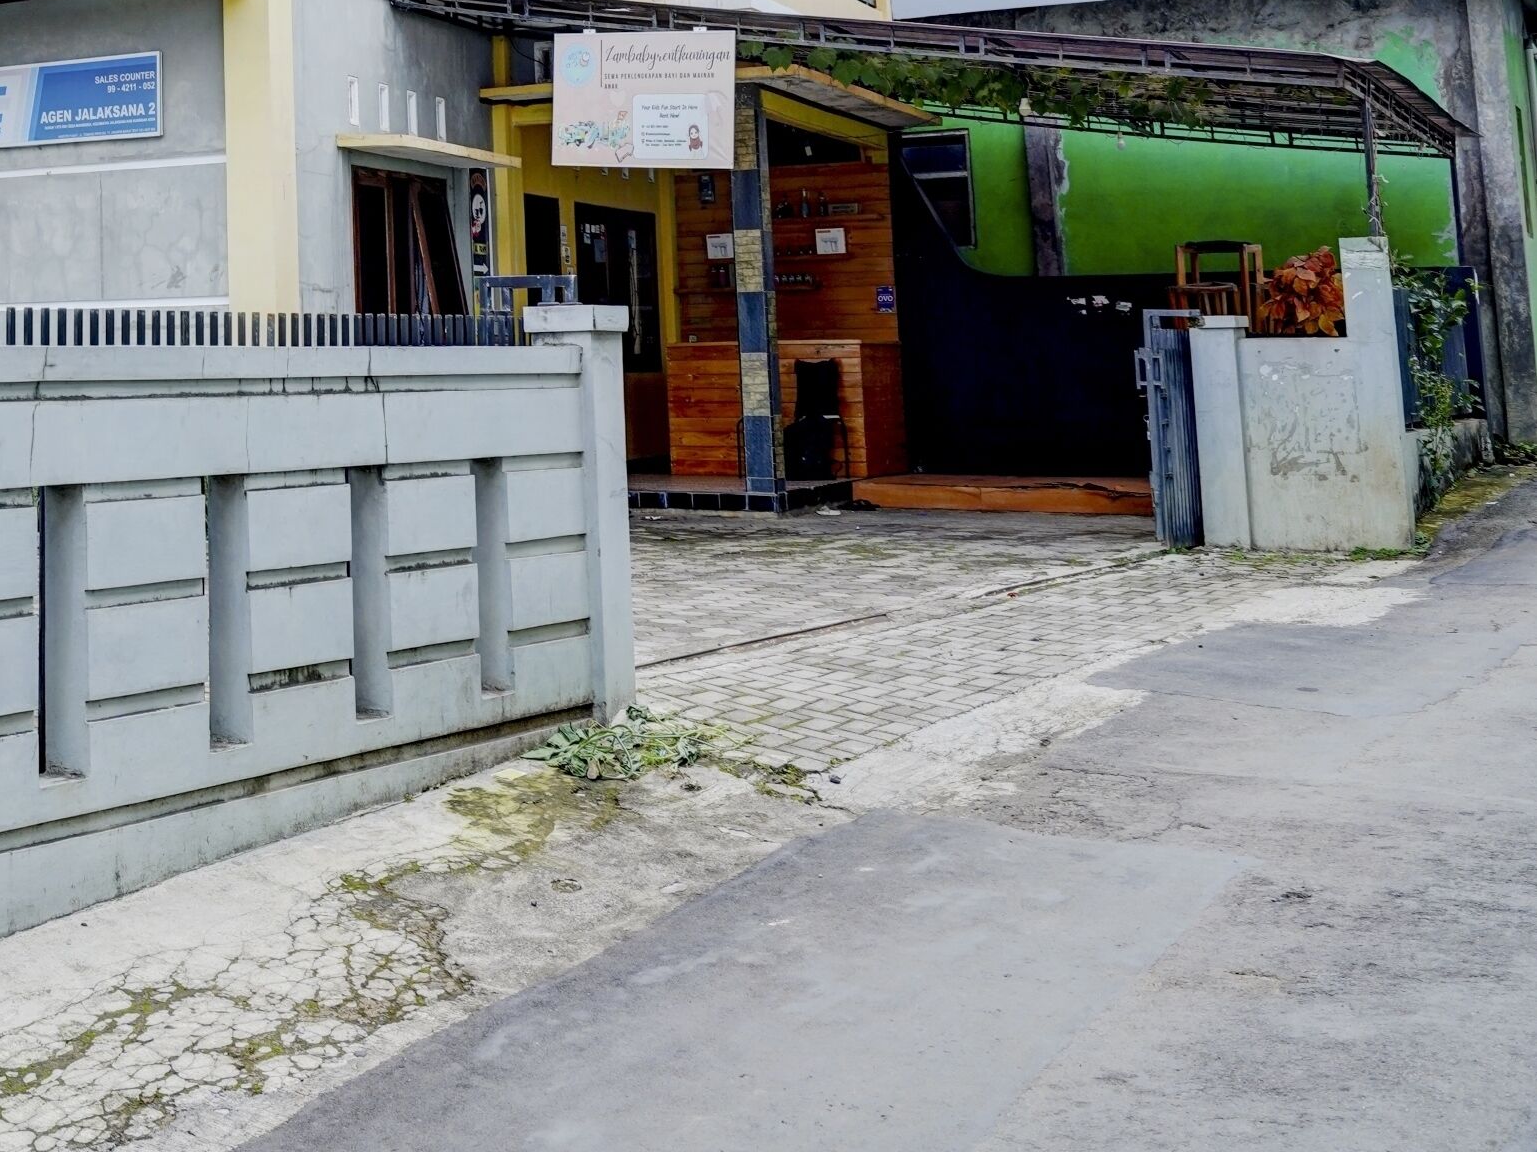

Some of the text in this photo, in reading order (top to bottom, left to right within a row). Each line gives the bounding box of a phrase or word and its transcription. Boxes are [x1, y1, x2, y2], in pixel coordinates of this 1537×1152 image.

[94, 70, 155, 84] SALES COUNTER
[107, 85, 116, 93] 99
[121, 83, 137, 92] 4211
[143, 81, 155, 90] 052
[40, 109, 72, 124] AGEN
[75, 103, 146, 121] JALAKSANA
[148, 102, 155, 115] 2
